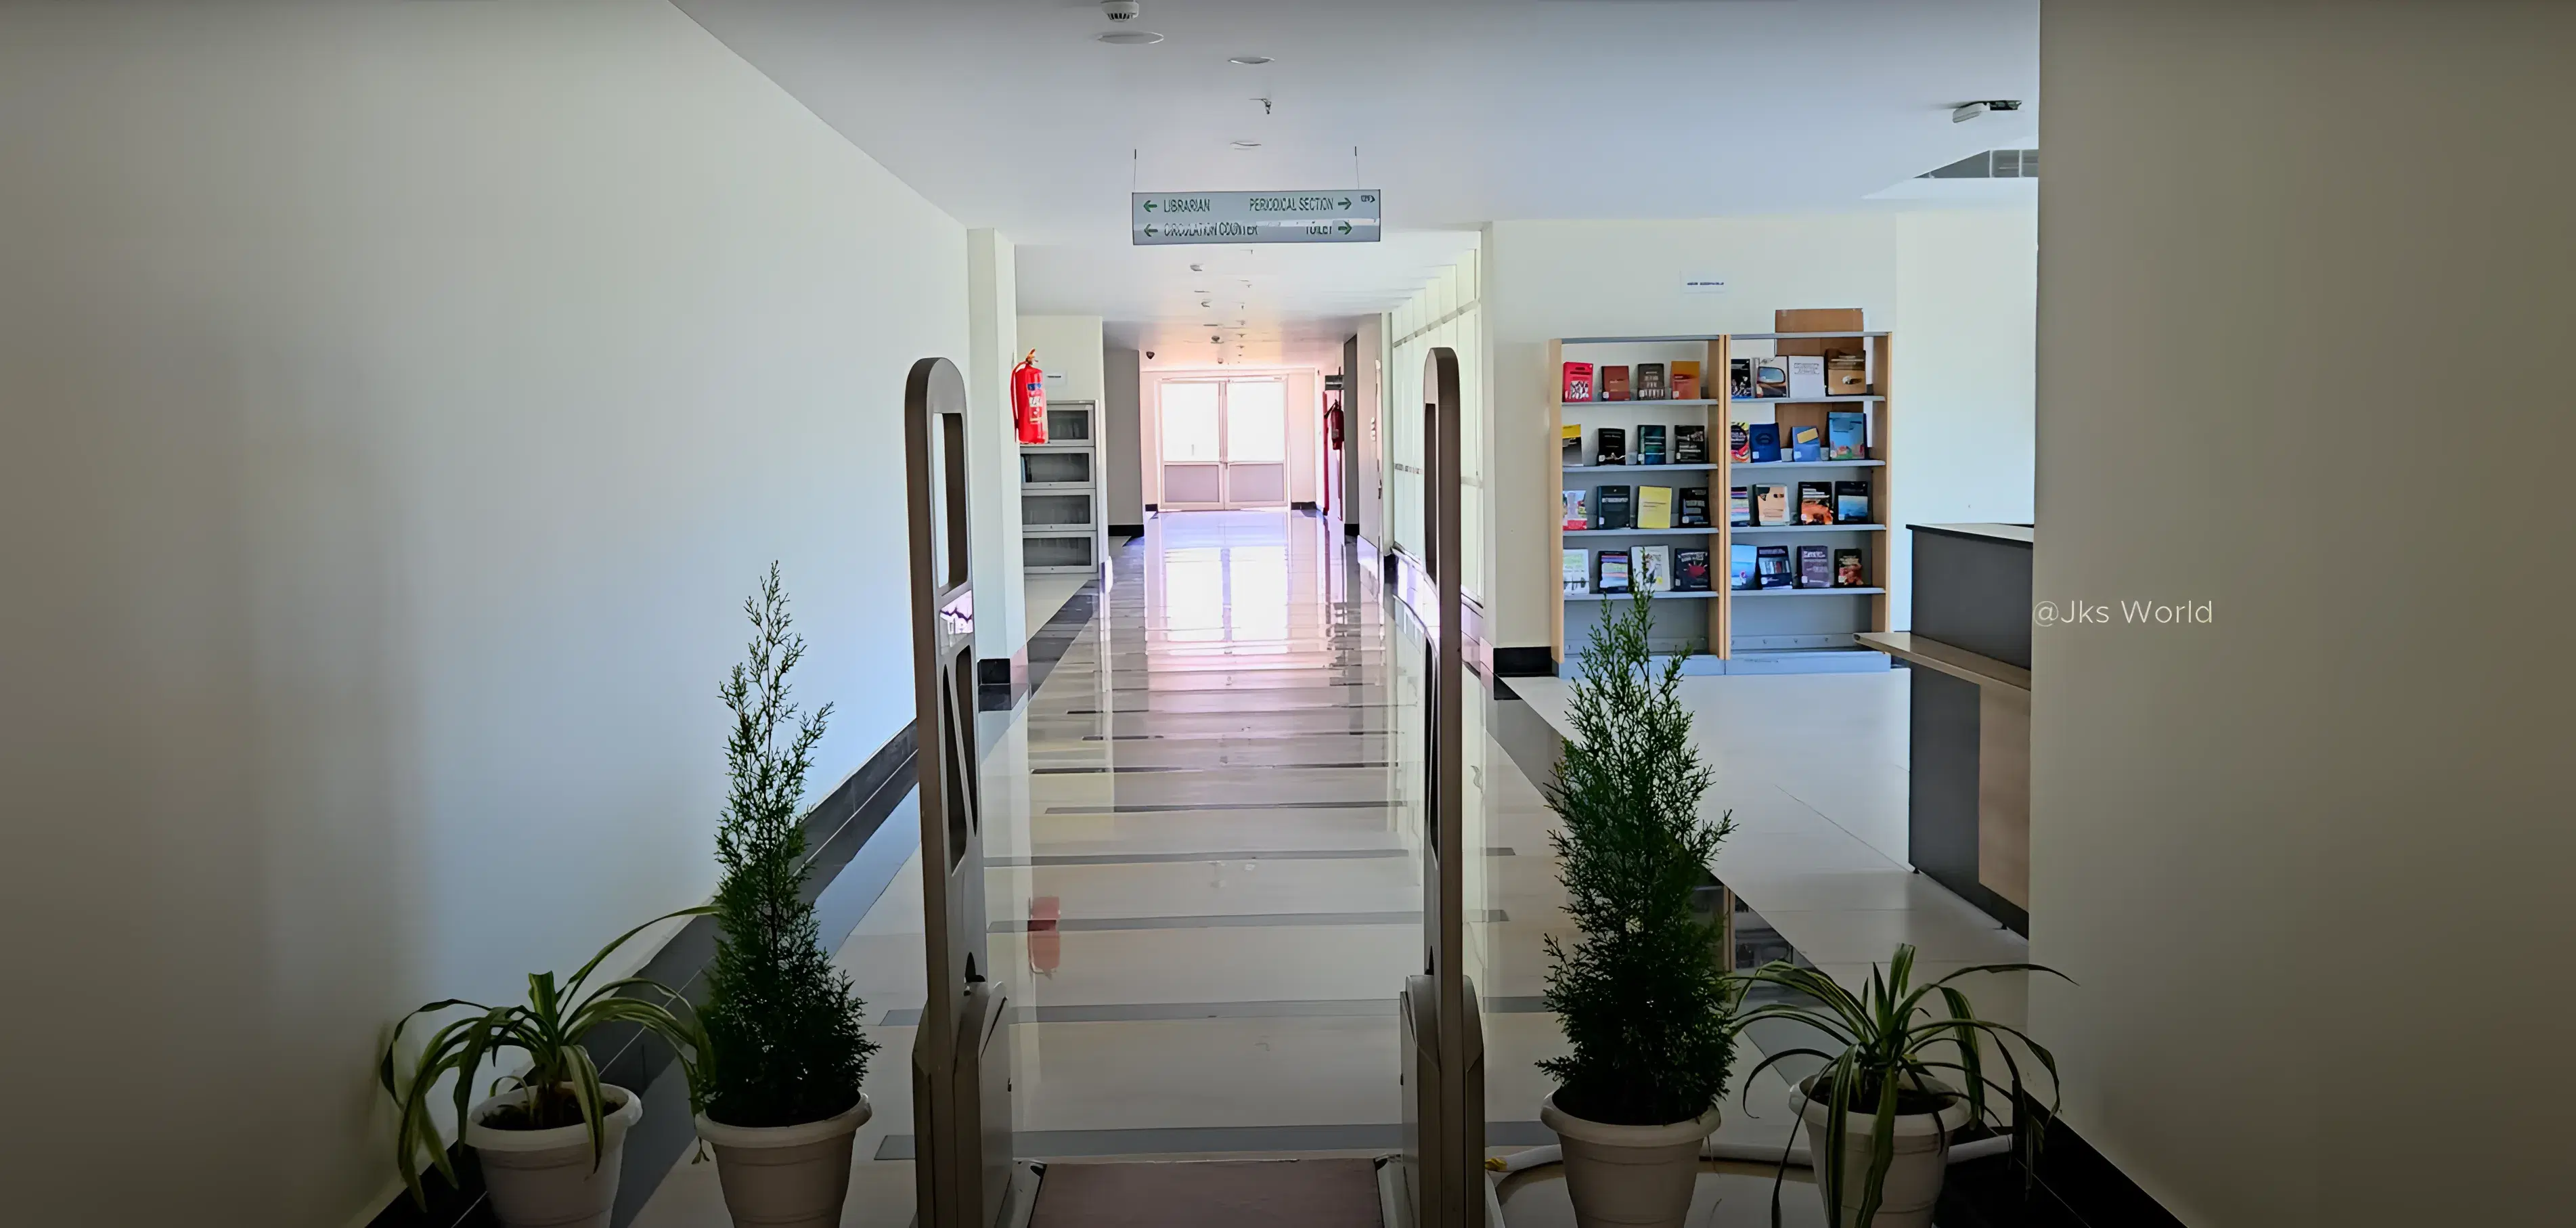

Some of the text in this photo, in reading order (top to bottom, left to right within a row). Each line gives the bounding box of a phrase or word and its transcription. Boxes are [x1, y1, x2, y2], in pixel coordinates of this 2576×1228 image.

[1163, 199, 1210, 213] LIBRARIAN
[1249, 197, 1334, 211] PERIODICAL SECTION
[1218, 222, 1258, 236] COUNTER
